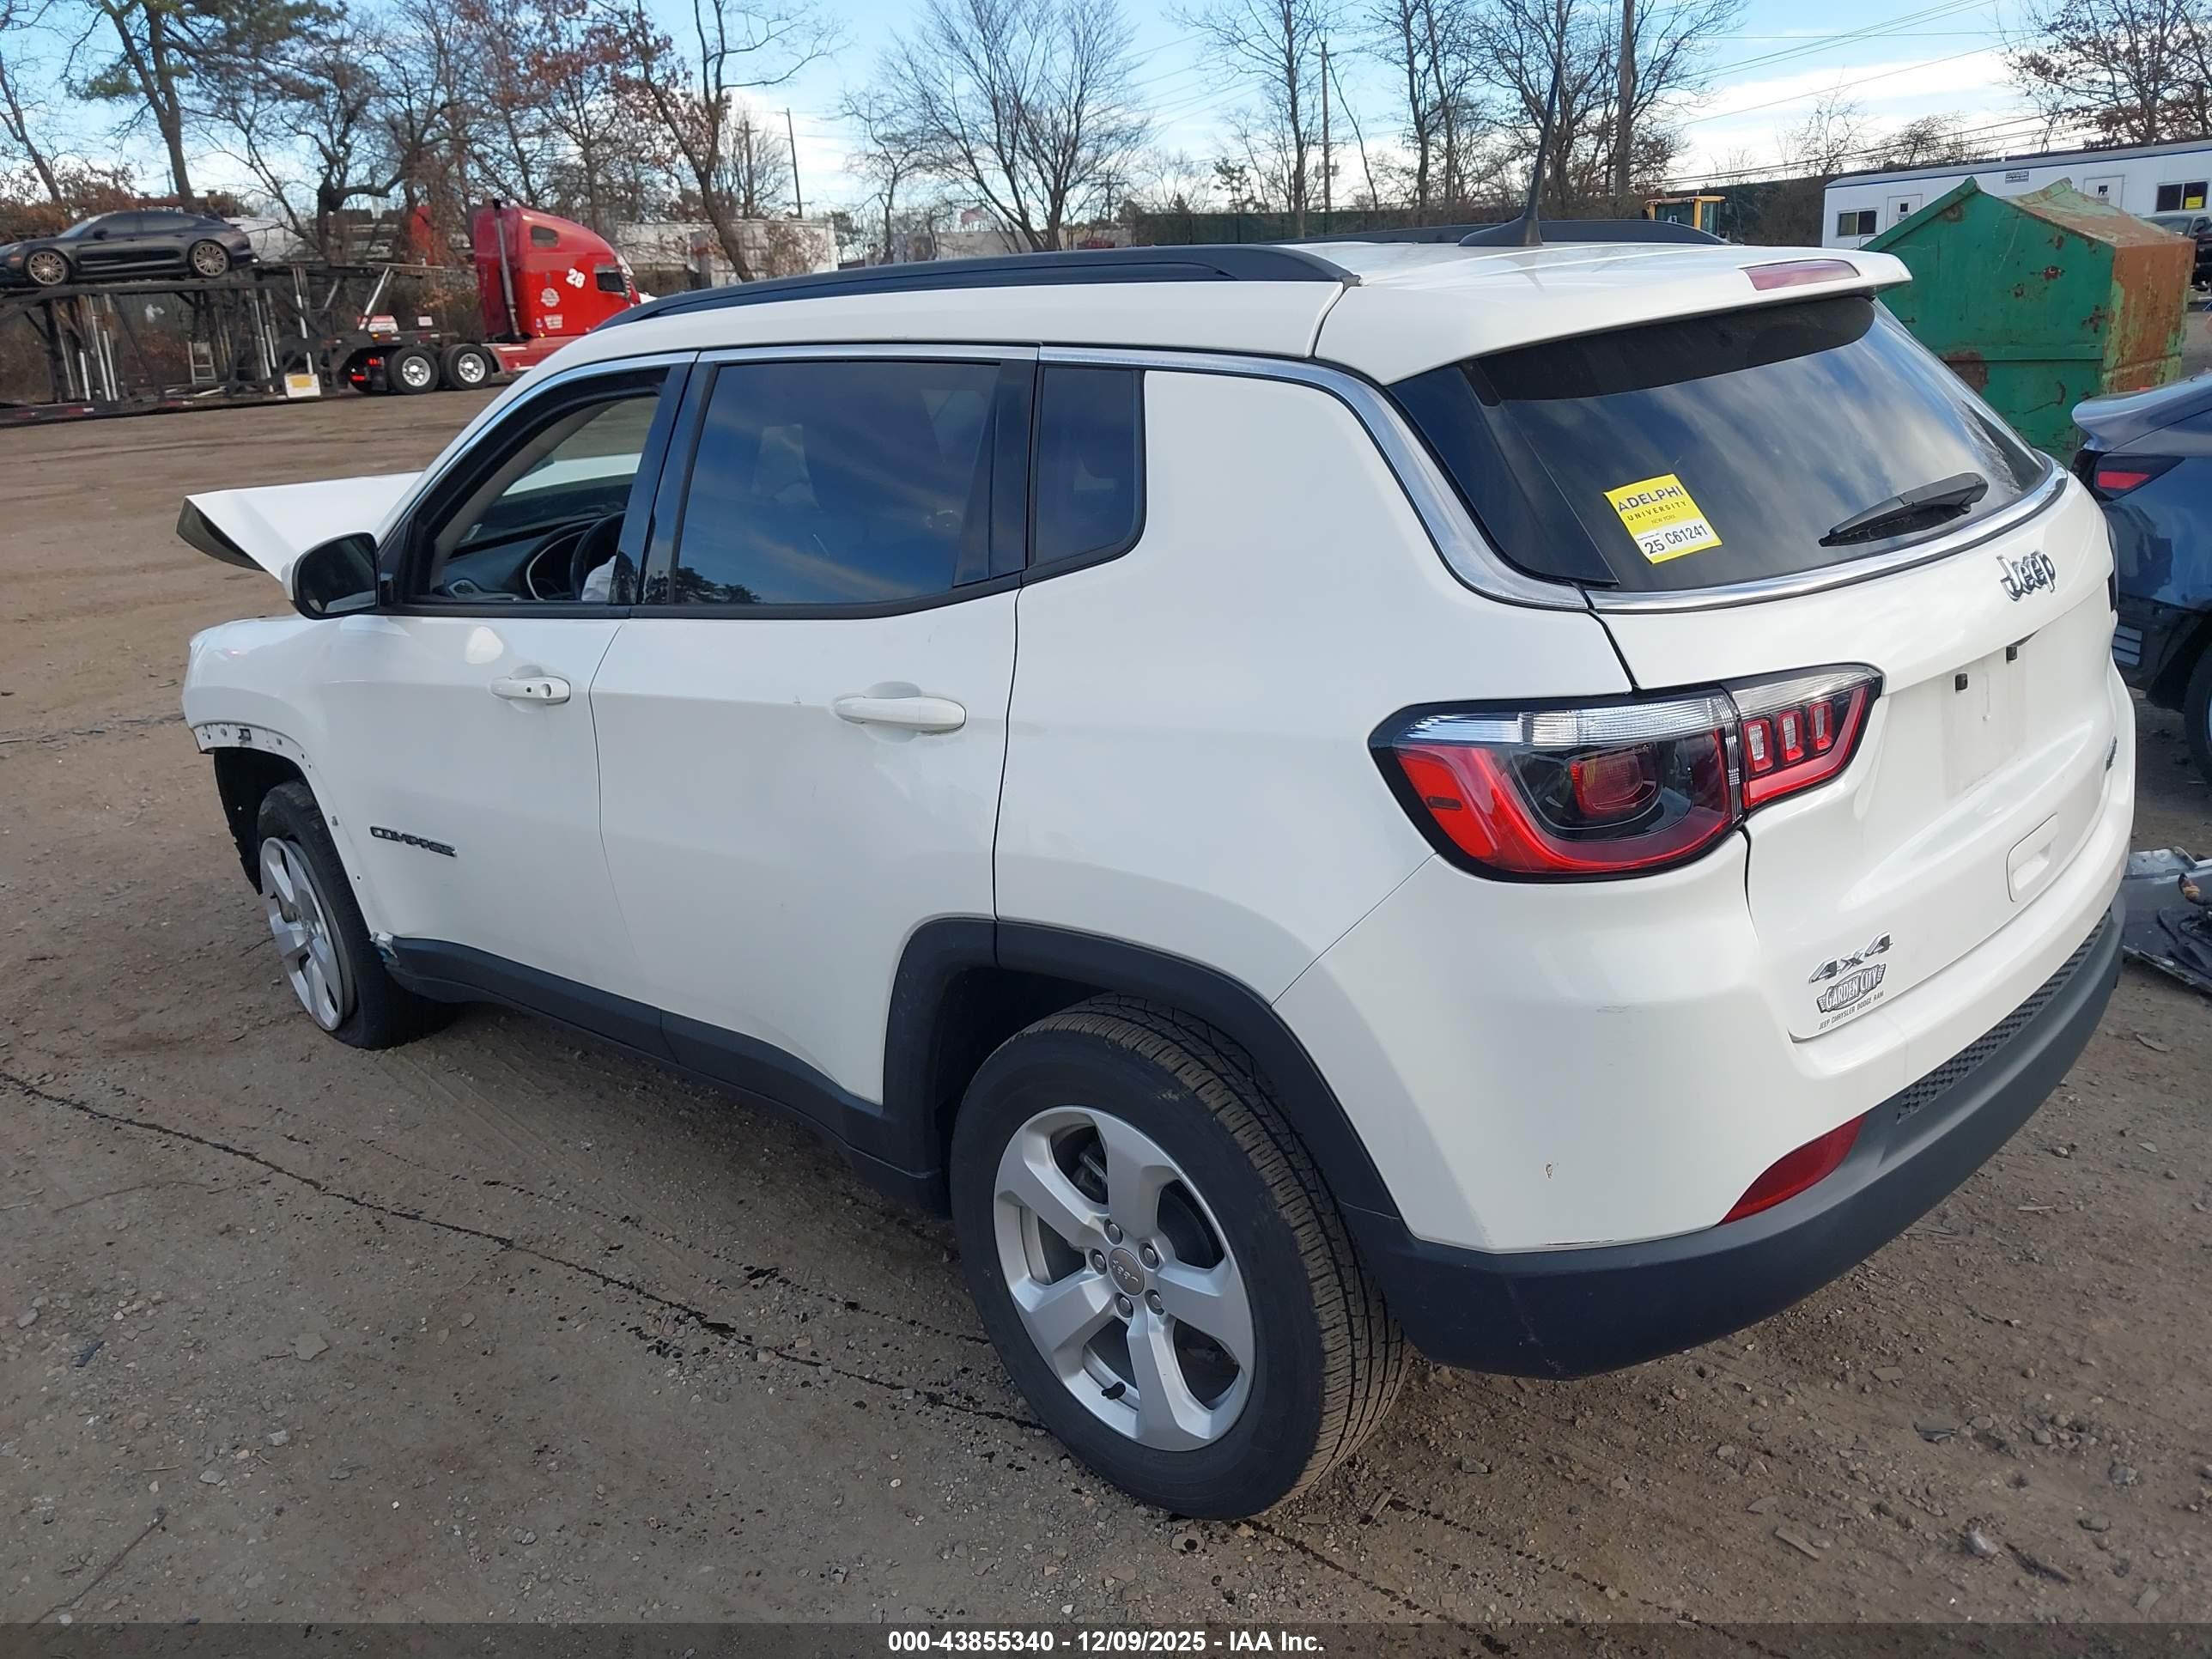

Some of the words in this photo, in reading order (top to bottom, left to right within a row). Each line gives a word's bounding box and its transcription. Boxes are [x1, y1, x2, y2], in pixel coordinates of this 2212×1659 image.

[566, 268, 586, 289] 28
[1618, 486, 1683, 512] ADELPHI
[1627, 500, 1688, 521] UNIVERSITY
[1644, 539, 1665, 555] 25
[1664, 524, 1708, 544] C61241
[1996, 551, 2056, 602] Jeep
[1808, 932, 1893, 983] 4x4
[1826, 975, 1862, 1010] GARDEN
[1859, 967, 1881, 994] CITY
[1819, 1018, 1830, 1030] JEEP
[1831, 1006, 1855, 1020] CHRYSLER
[1857, 998, 1872, 1011] DODGE
[1873, 990, 1884, 1000] RAM
